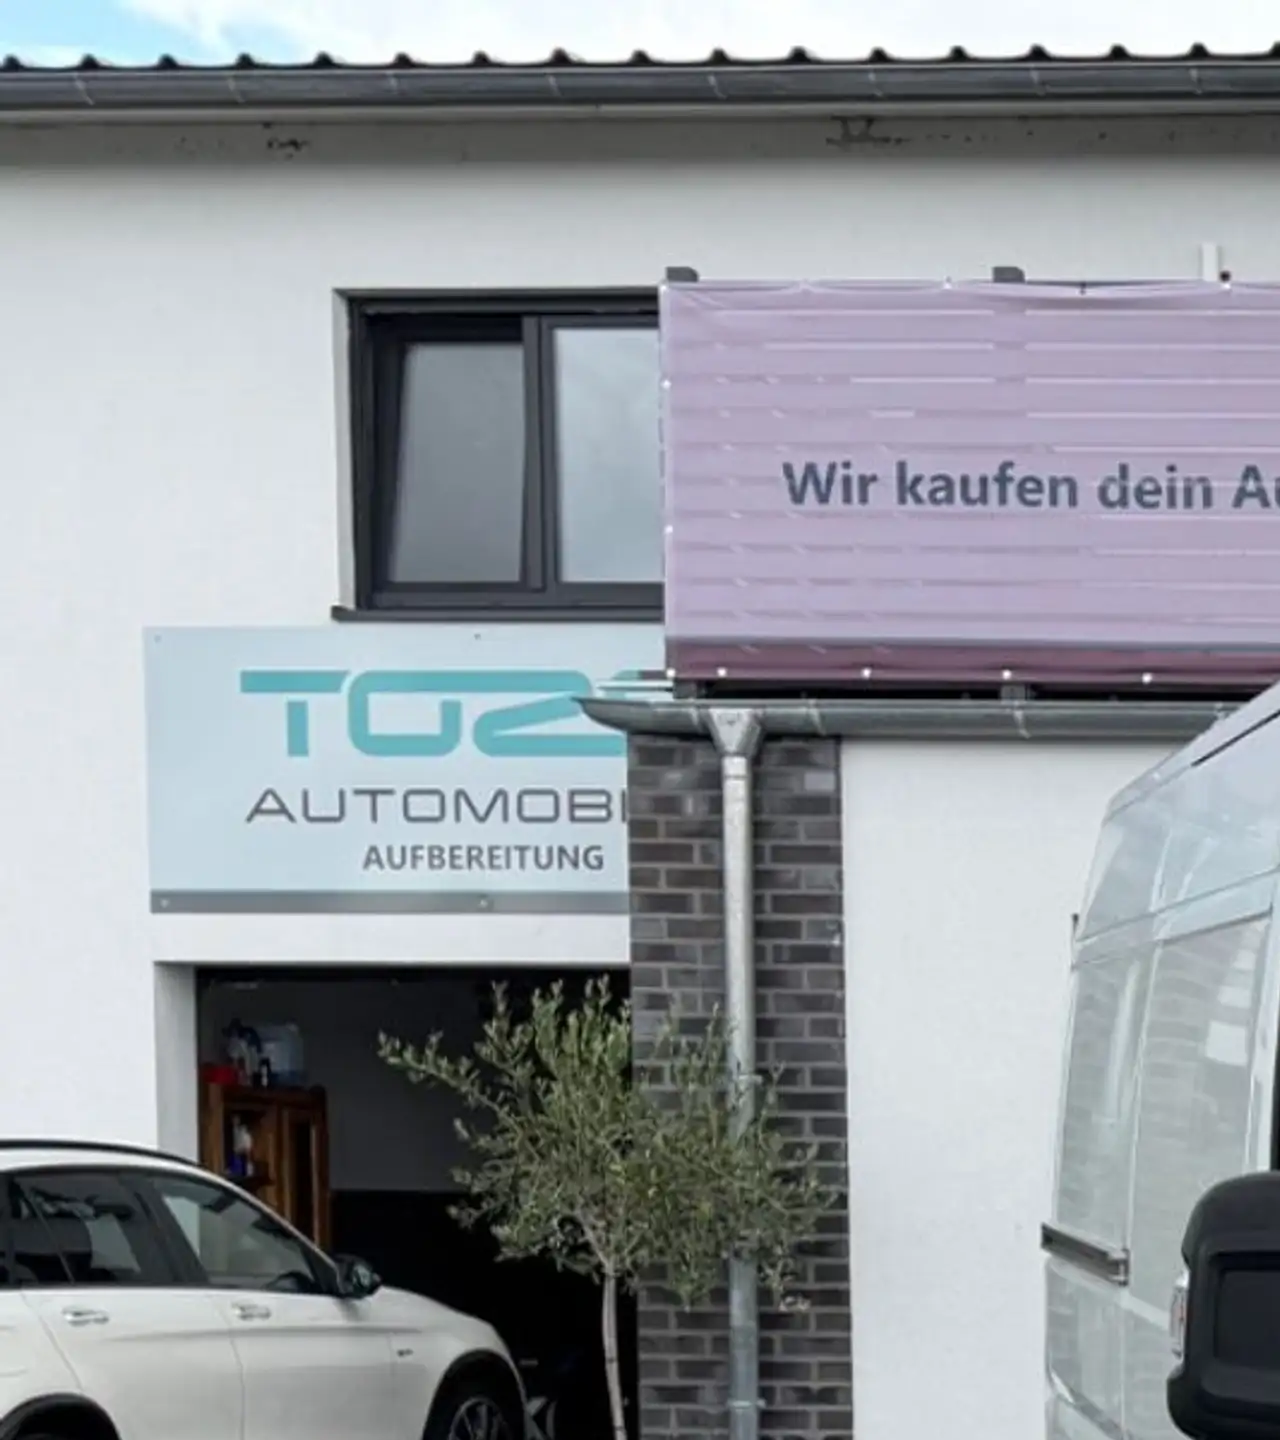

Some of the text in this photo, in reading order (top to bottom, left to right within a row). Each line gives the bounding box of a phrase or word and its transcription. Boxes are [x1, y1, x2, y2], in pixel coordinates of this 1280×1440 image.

[782, 461, 878, 506] Wir
[896, 461, 1079, 508] kaufen
[1097, 463, 1213, 510] dein
[240, 670, 641, 757] TOZ
[363, 844, 605, 871] AUFBEREITUNG
